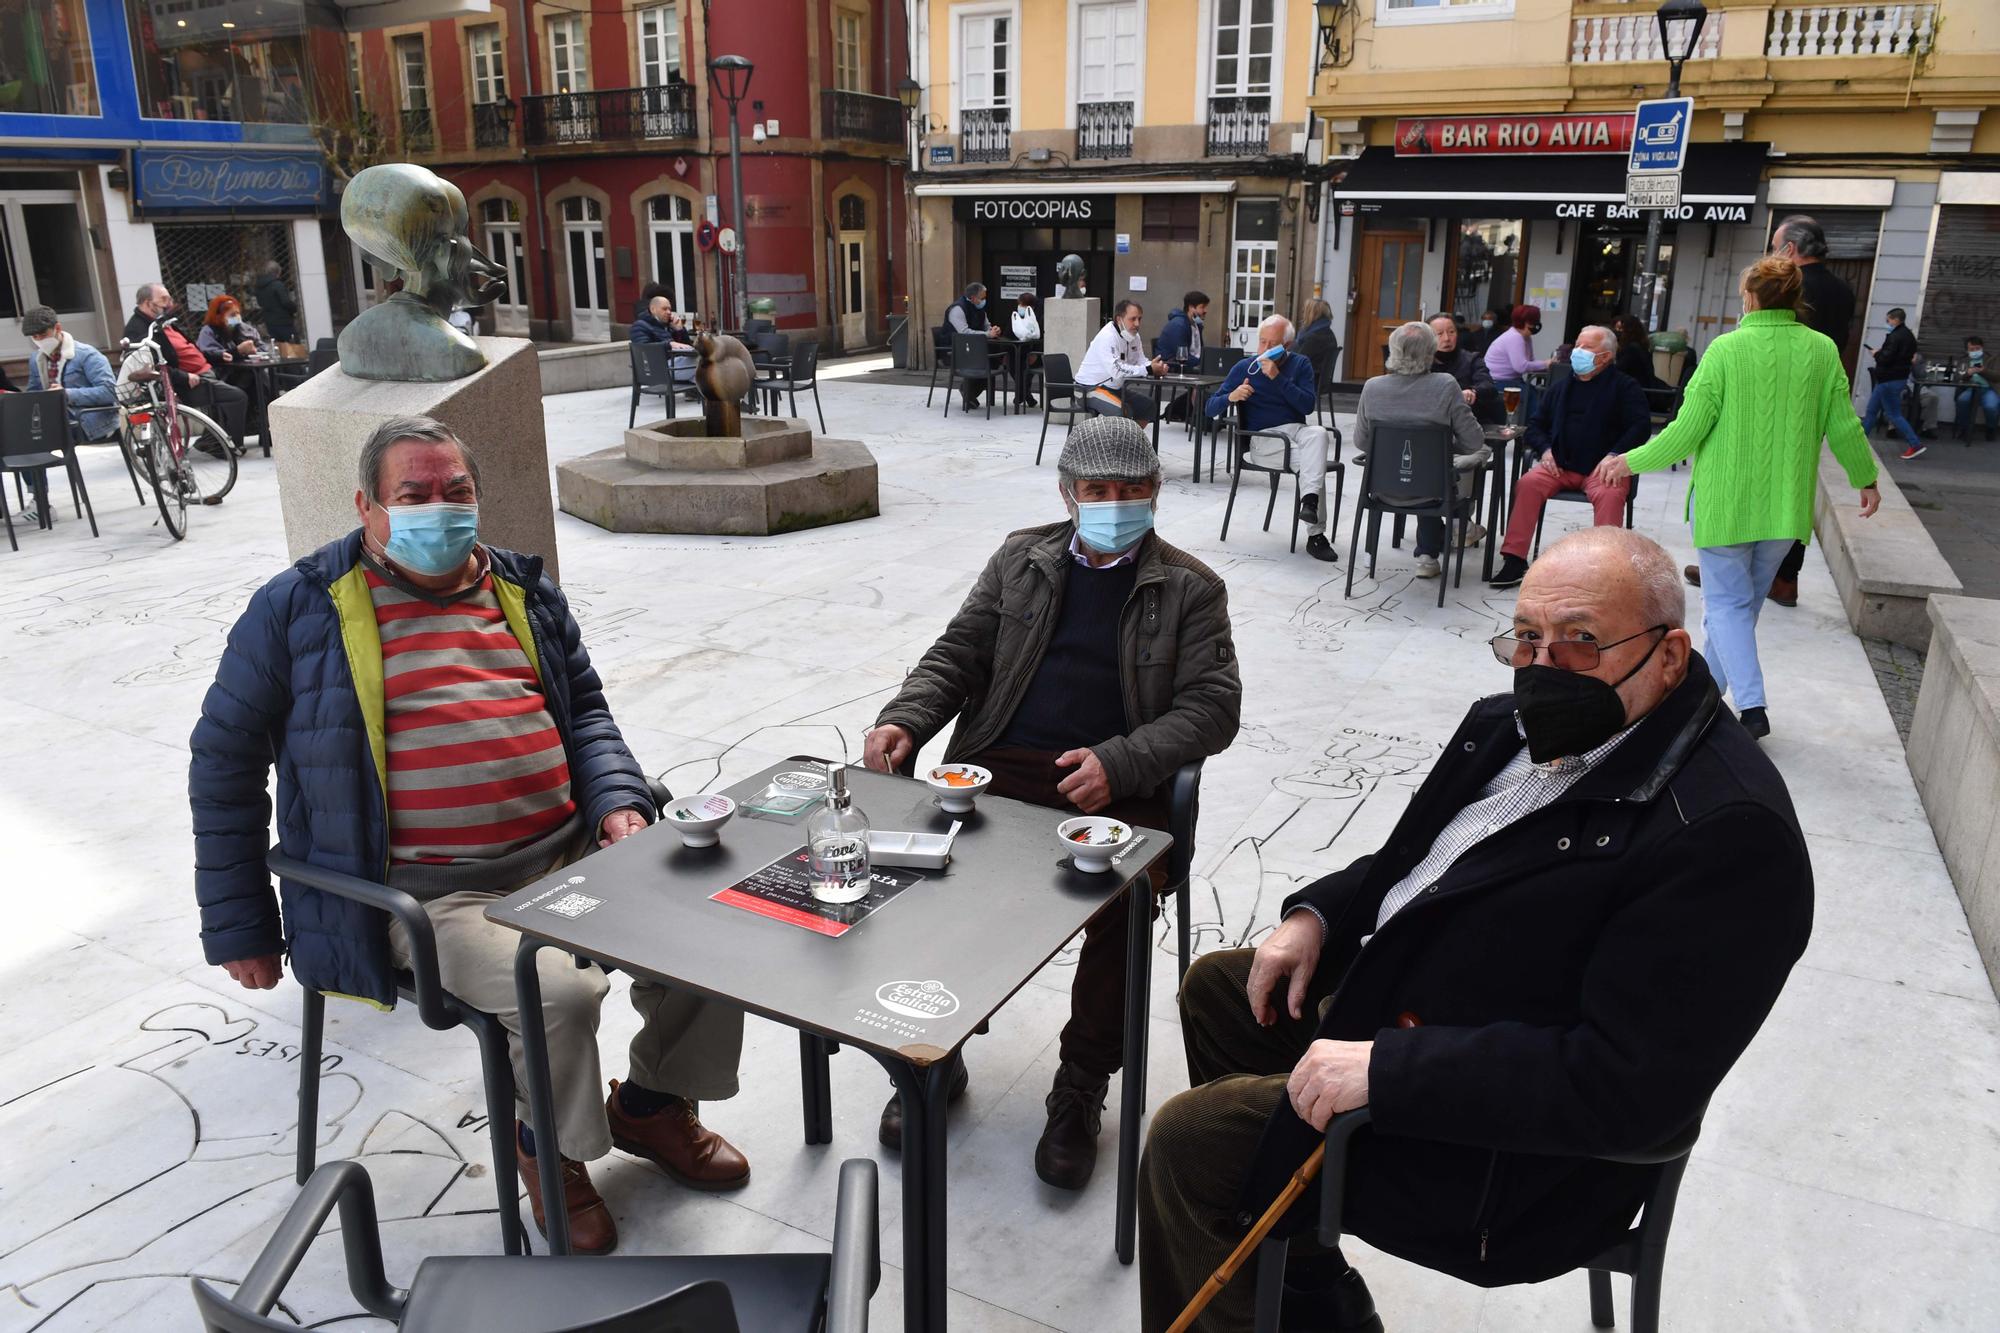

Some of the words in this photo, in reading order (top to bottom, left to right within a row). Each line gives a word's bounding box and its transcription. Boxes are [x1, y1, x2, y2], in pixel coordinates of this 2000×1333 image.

[1441, 124, 1489, 147] BAR
[1497, 123, 1539, 146] RIO
[1548, 121, 1610, 146] AVIA
[1652, 151, 1678, 161] VIGILADA
[1656, 192, 1677, 204] Local
[974, 200, 1092, 218] FOTOCOPIAS
[1556, 204, 1595, 218] CAFE
[1606, 204, 1640, 218] BAR
[1663, 206, 1694, 219] RIO
[1704, 206, 1747, 220] AVIA
[766, 868, 792, 876] normas
[888, 991, 940, 1014] Galicia
[892, 983, 951, 1007] Estrella
[854, 1015, 888, 1030] DESDE
[858, 1008, 927, 1033] RESISTENCIA
